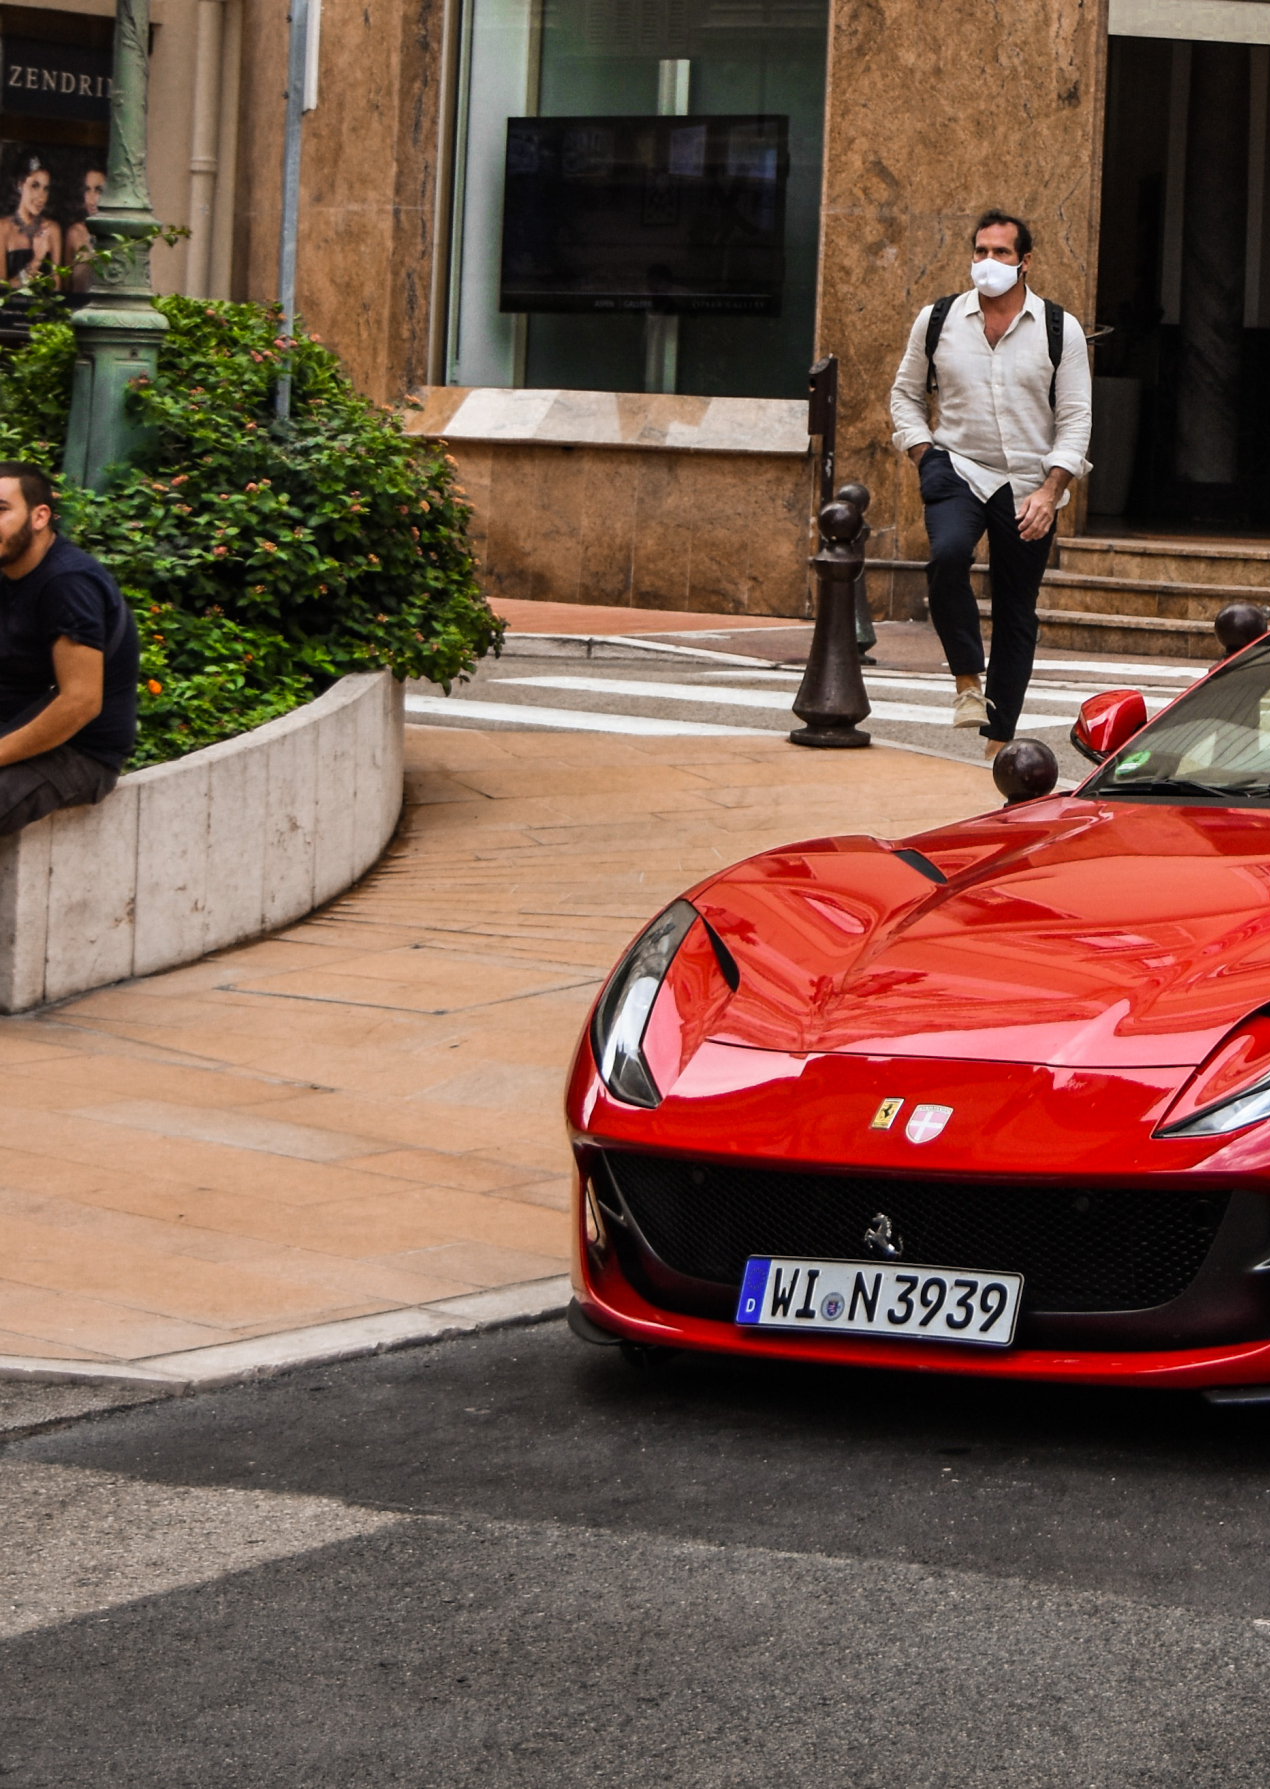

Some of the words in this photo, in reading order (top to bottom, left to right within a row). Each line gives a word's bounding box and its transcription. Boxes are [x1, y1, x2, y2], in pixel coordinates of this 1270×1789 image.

[9, 65, 112, 98] ZENDRI
[745, 1298, 756, 1313] D
[771, 1267, 821, 1320] WI
